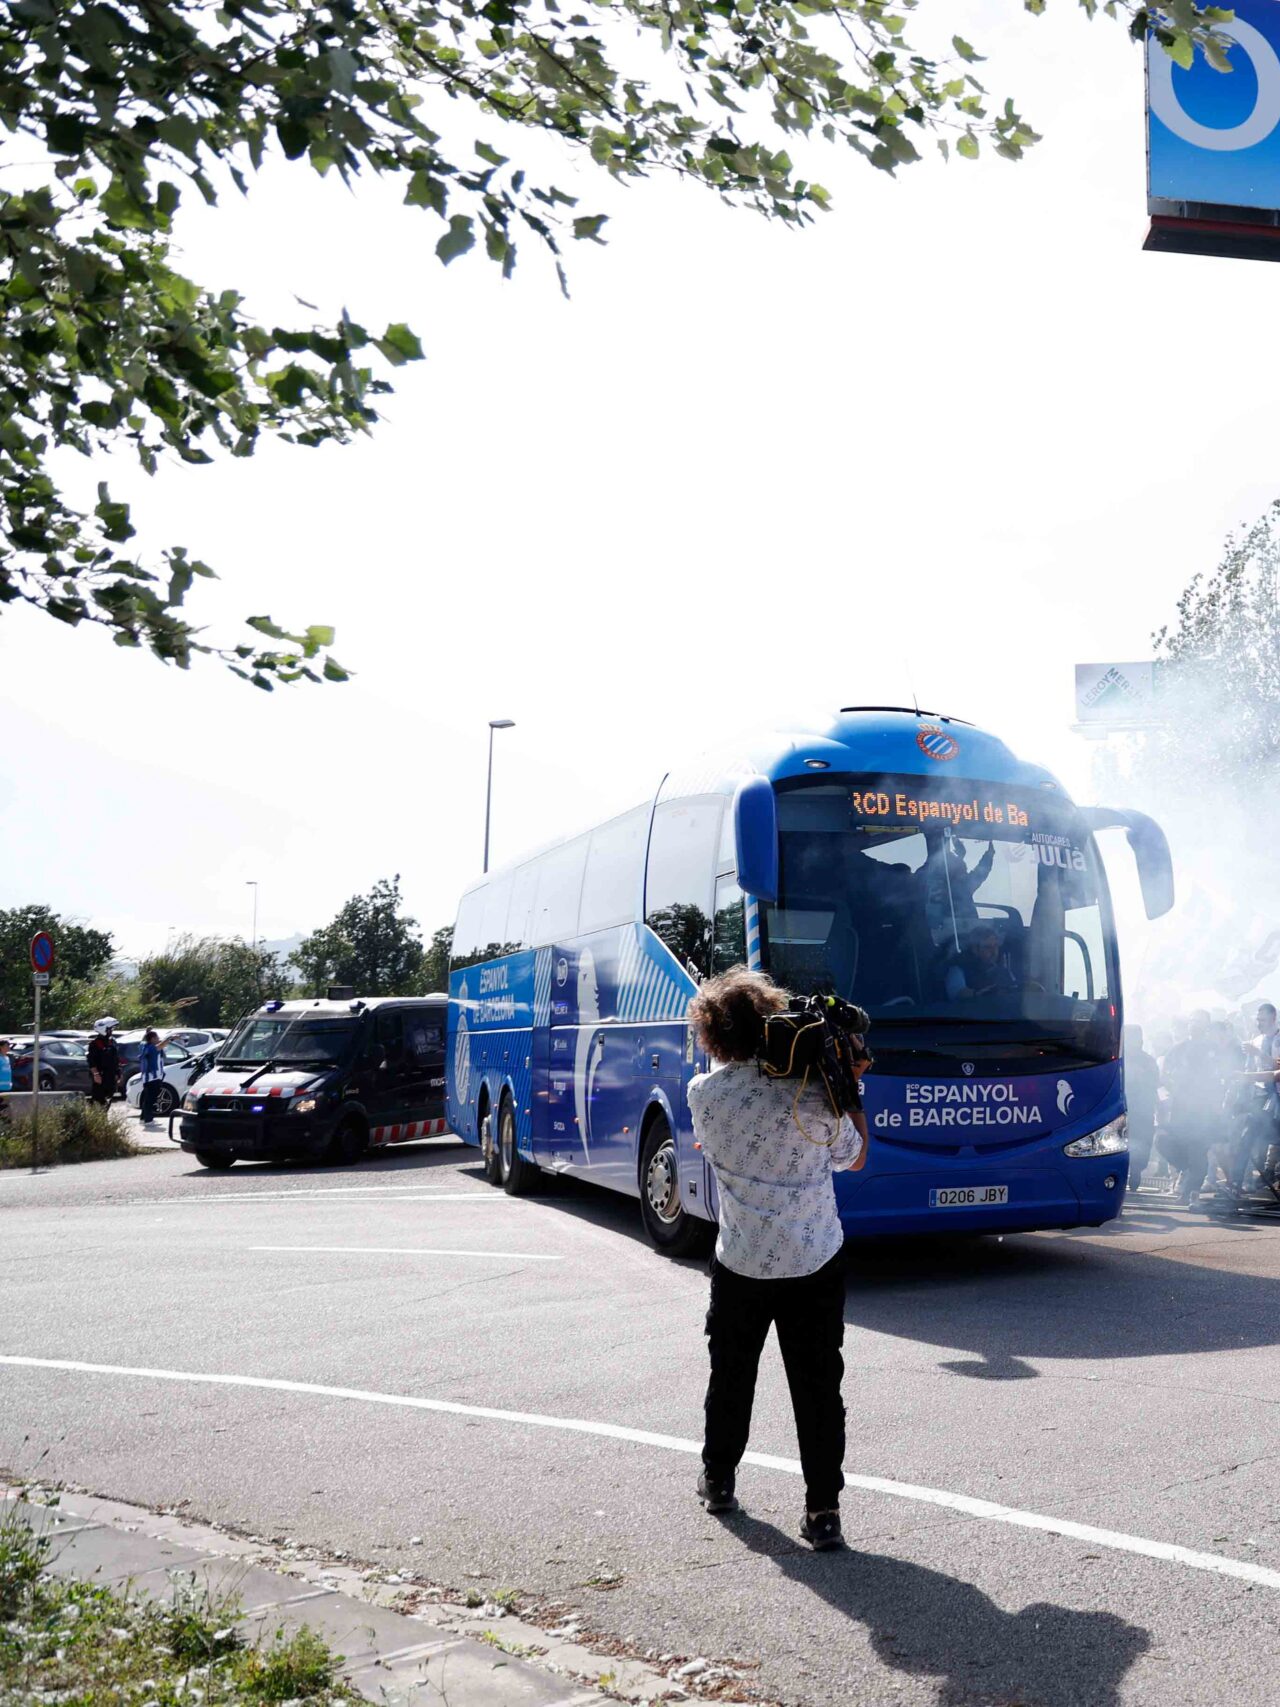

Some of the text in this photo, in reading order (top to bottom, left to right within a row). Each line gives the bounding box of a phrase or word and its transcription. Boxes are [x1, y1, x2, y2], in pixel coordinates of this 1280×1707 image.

[1080, 674, 1111, 706] LEROY
[895, 794, 979, 824] Espanyol
[984, 807, 1003, 823] de
[1007, 804, 1028, 826] Ba
[1031, 833, 1071, 848] AUTOCARES
[906, 1084, 1019, 1104] ESPANYOL
[875, 1106, 1043, 1127] de BARCELONA
[939, 1186, 1007, 1206] 0206 JBY
